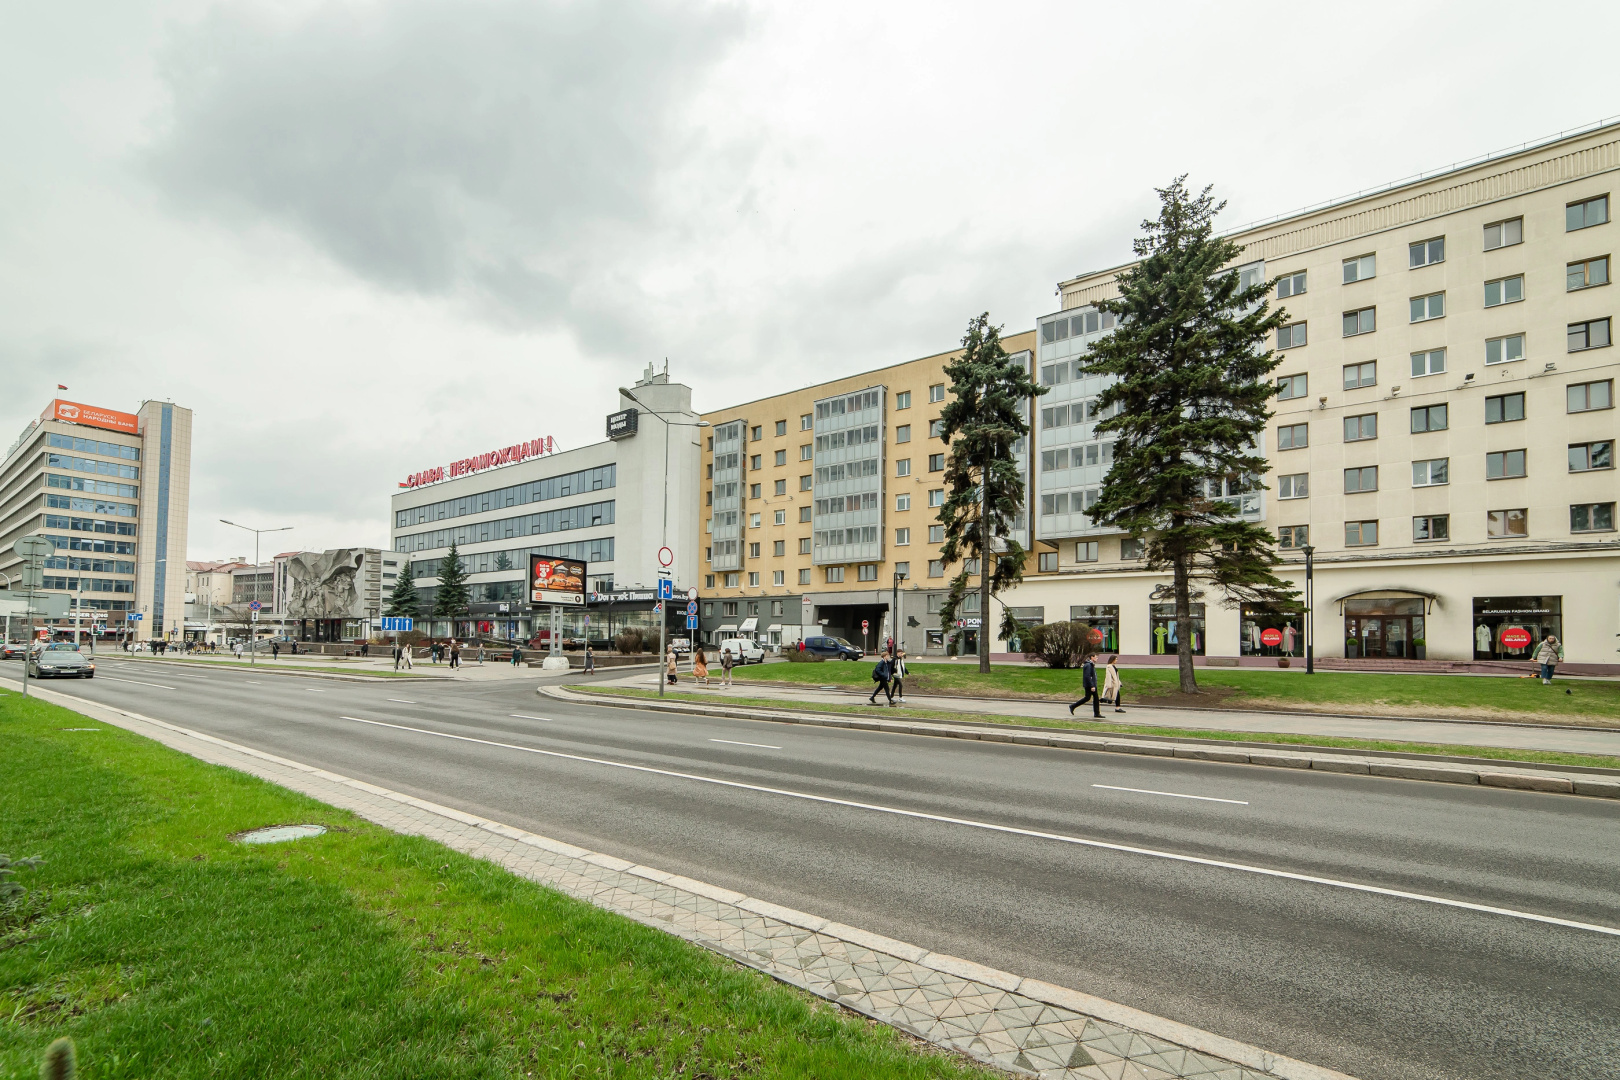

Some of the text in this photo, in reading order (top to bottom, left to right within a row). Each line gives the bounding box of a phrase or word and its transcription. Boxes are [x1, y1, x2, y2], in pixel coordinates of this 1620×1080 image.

[83, 410, 116, 420] БЕЛАРУСКІ
[83, 414, 116, 424] НАРОДНЫ
[406, 466, 444, 488] СЛАВА
